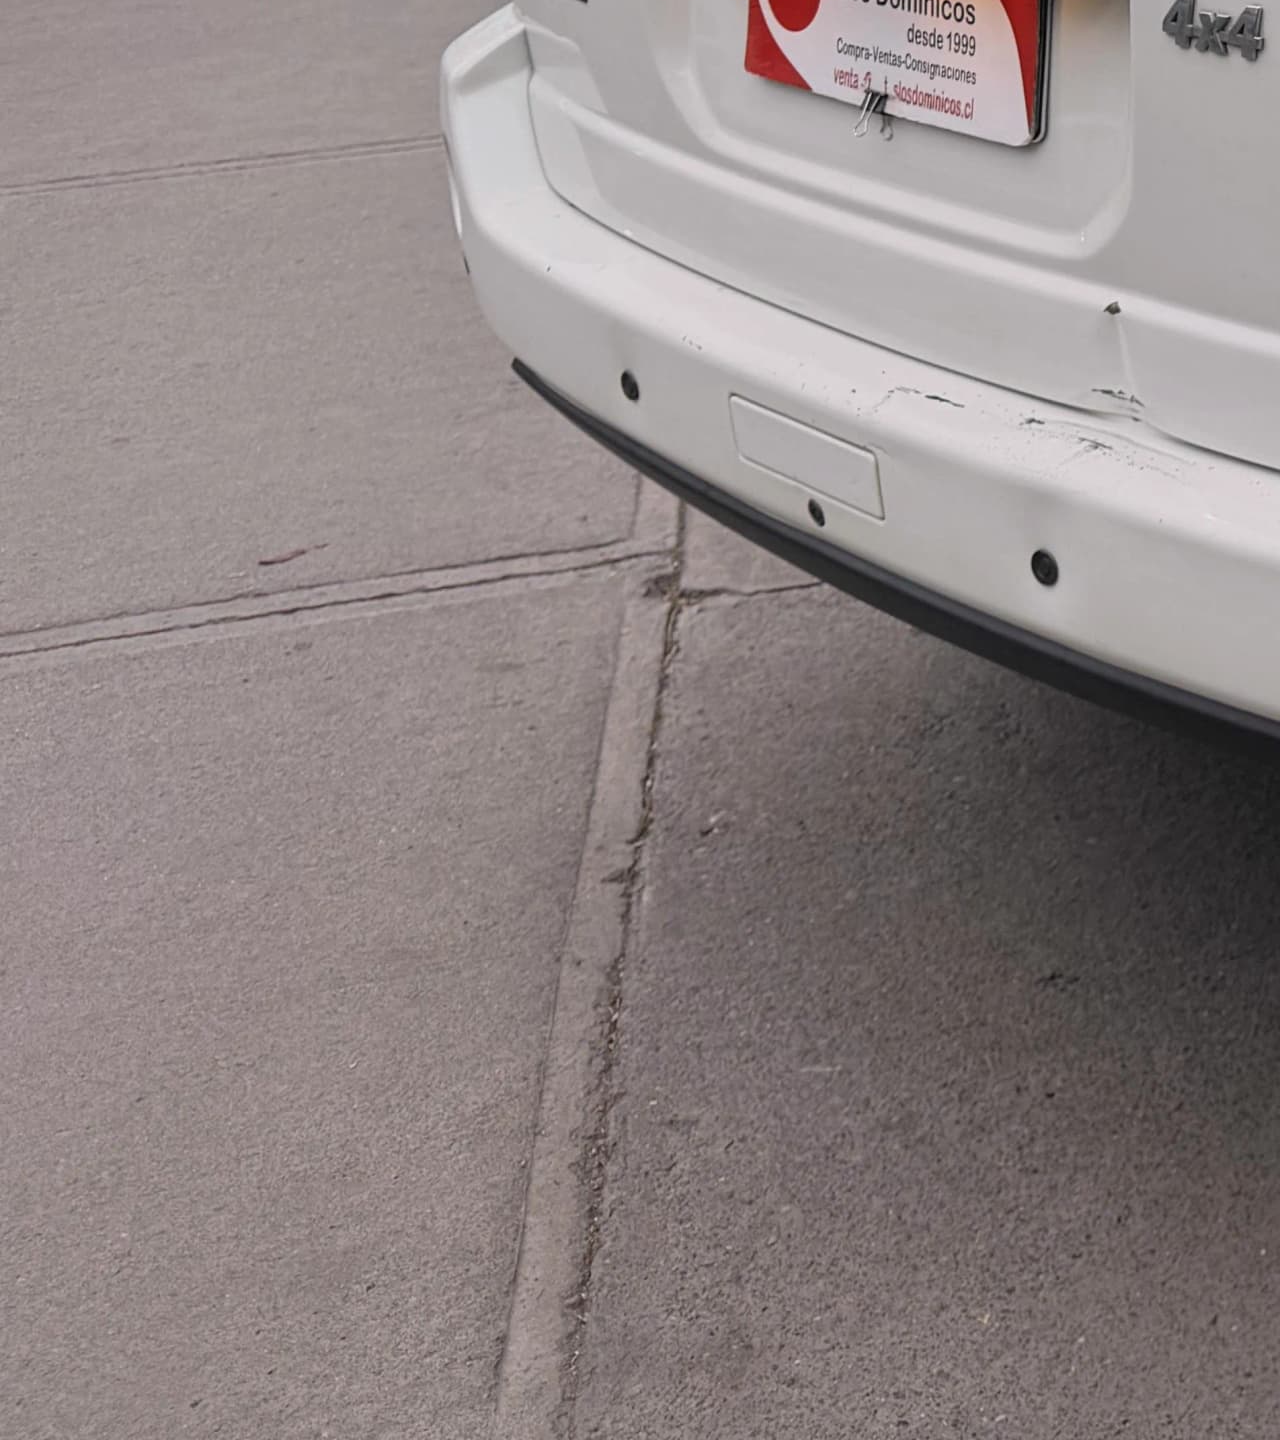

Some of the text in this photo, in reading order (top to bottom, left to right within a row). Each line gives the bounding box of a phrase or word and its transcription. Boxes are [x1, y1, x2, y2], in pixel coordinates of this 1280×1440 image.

[907, 24, 976, 57] desde 1999
[836, 37, 977, 85] Compra-Ventas-Consignaciones
